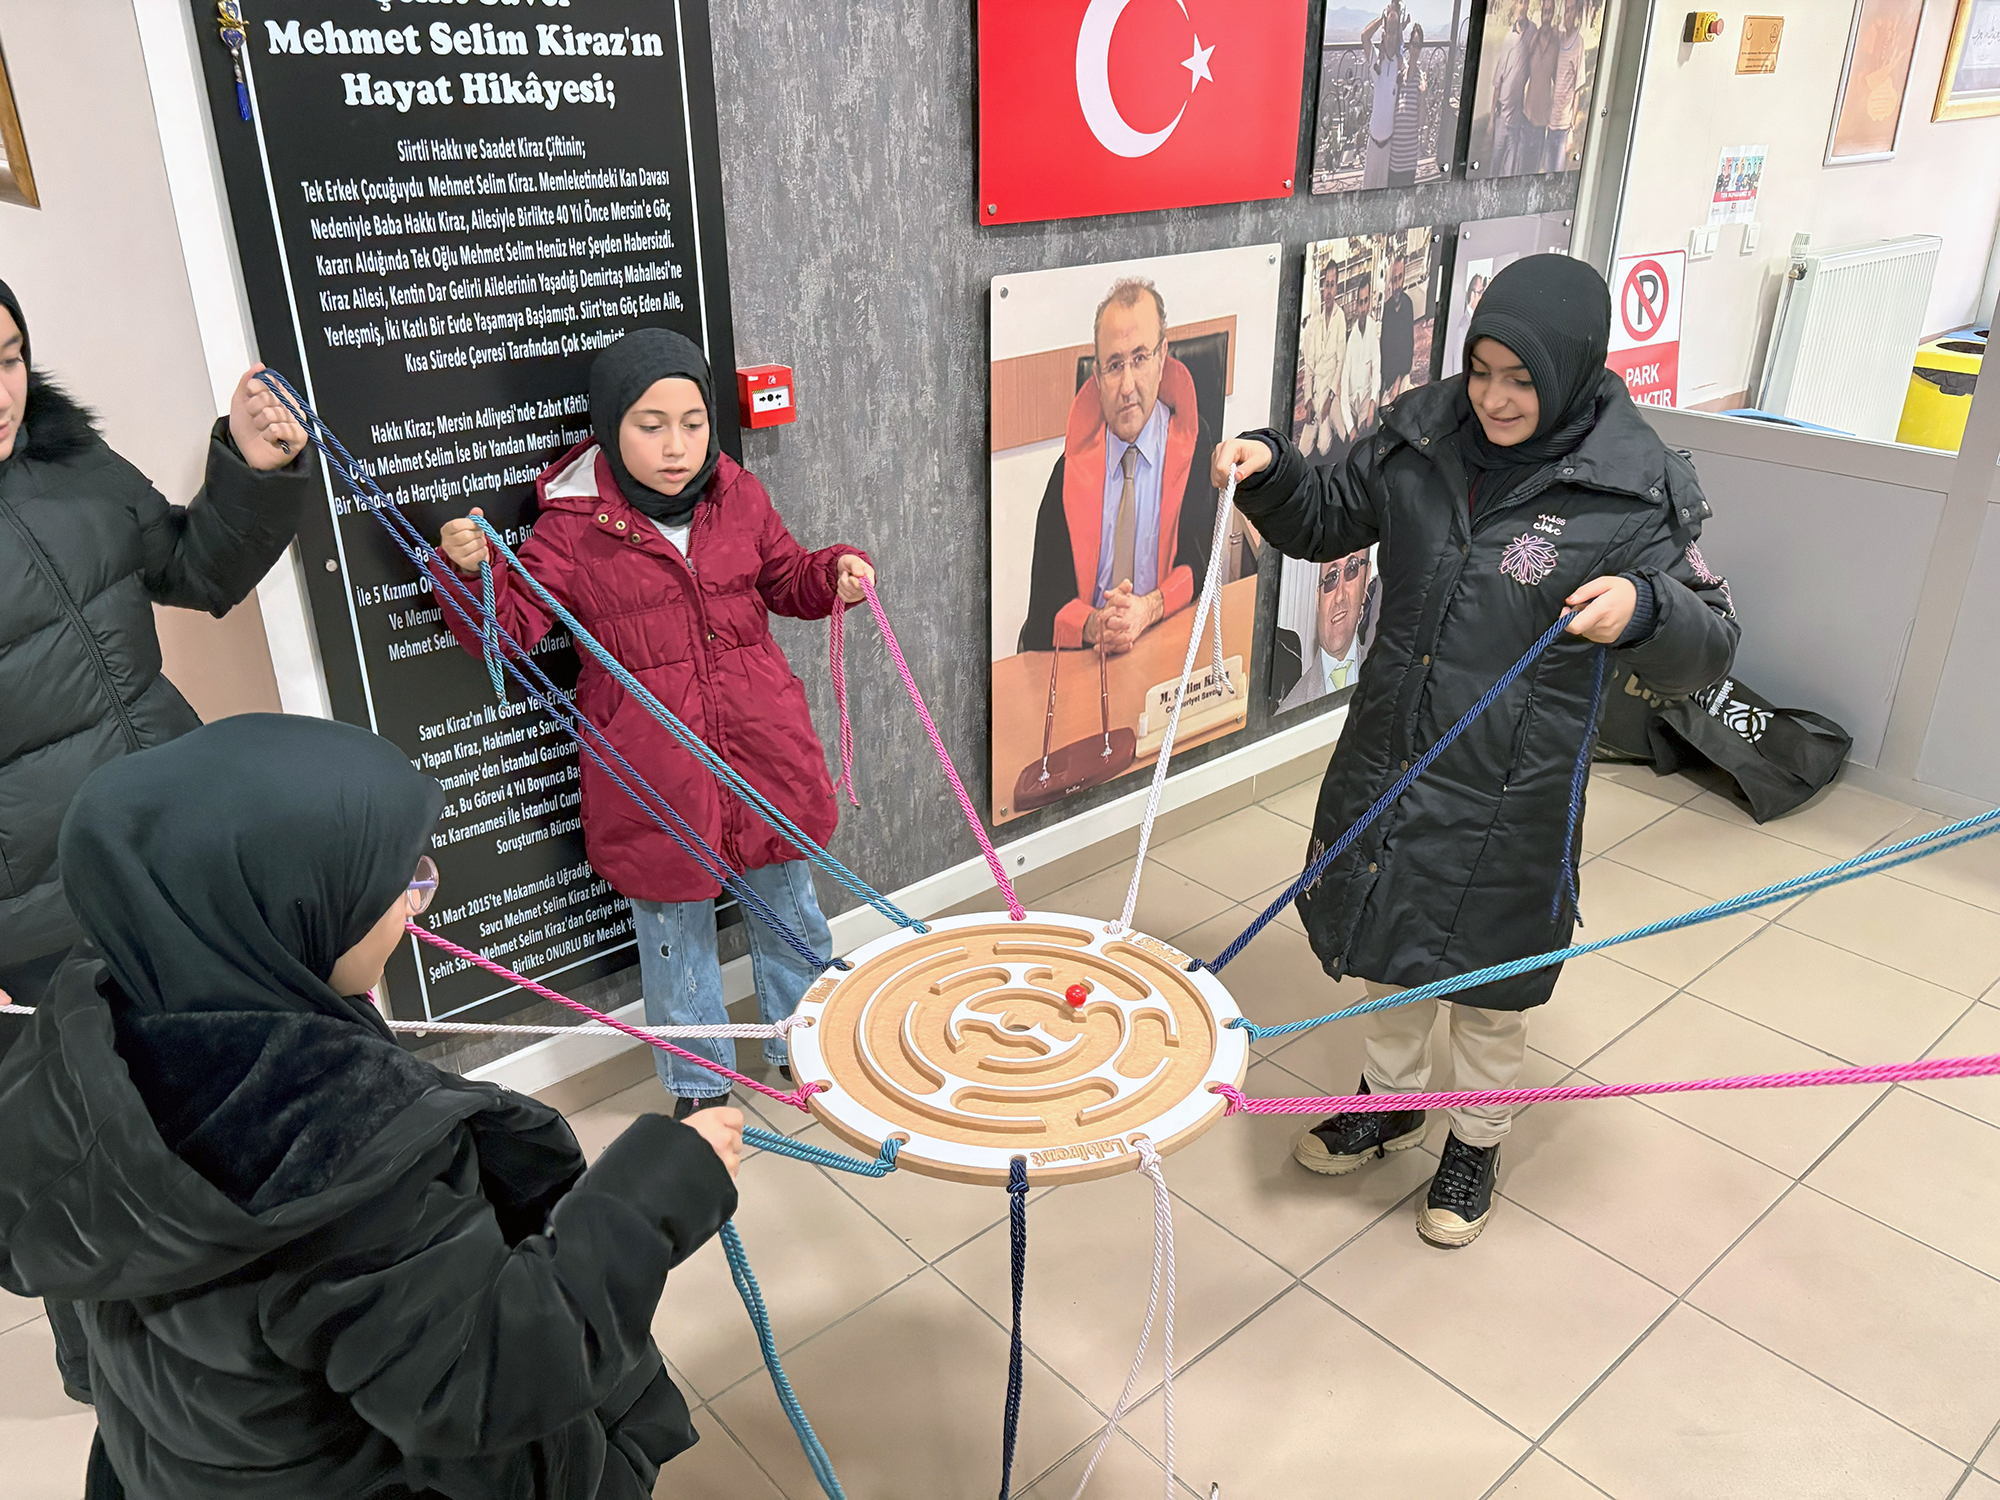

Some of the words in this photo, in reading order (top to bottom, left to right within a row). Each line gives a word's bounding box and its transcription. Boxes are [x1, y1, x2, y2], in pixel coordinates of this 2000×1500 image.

[264, 20, 422, 55] Mehmet
[429, 21, 529, 55] Selim
[535, 24, 664, 57] Kiraz'ın
[341, 72, 454, 113] Hayat
[459, 71, 616, 111] Hikâyesi;
[397, 138, 430, 162] Siirtli
[430, 138, 463, 161] Hakkı
[463, 143, 478, 160] ve
[479, 136, 517, 159] Saadet
[517, 136, 545, 158] Kiraz
[545, 135, 586, 162] Çiftinin;
[300, 179, 325, 203] Tek
[324, 178, 360, 202] Erkek
[360, 175, 424, 205] Çocuğuydu
[428, 174, 476, 197] Mehmet
[476, 172, 507, 195] Selim
[507, 172, 538, 193] Kiraz.
[538, 167, 618, 192] Memleketindeki
[619, 168, 638, 188] Kan
[638, 167, 670, 186] Davası
[310, 214, 372, 242] Nedeniyle
[372, 213, 403, 236] Baba
[403, 211, 437, 234] Hakkı
[437, 210, 470, 234] Kiraz,
[471, 206, 516, 233] Ailesiyle
[516, 205, 555, 227] Birlikte
[556, 204, 569, 224] 40
[569, 202, 583, 223] Yıl
[584, 198, 610, 223] Önce
[610, 198, 652, 221] Mersin'e
[652, 198, 671, 221] Göç
[315, 255, 354, 276] Kararı
[356, 248, 410, 277] Aldığında
[410, 246, 432, 269] Tek
[432, 245, 459, 272] Oğlu
[459, 243, 505, 265] Mehmet
[505, 240, 535, 262] Selim
[535, 238, 568, 259] Henüz
[568, 237, 586, 257] Her
[587, 233, 623, 260] Şeyden
[623, 229, 675, 252] Habersizdi.
[319, 290, 351, 312] Kiraz
[352, 286, 389, 310] Ailesi,
[388, 283, 426, 306] Kentin
[426, 282, 447, 302] Dar
[448, 277, 483, 300] Gelirli
[484, 273, 538, 297] Ailelerinin
[537, 269, 579, 295] Yaşadığı
[580, 266, 624, 289] Demirtaş
[624, 260, 682, 283] Mahallesi'ne
[323, 322, 385, 349] Yerleşmiş,
[384, 316, 401, 341] İki
[401, 316, 428, 339] Katlı
[429, 315, 446, 336] Bir
[446, 312, 473, 334] Evde
[473, 312, 525, 335] Yaşamaya
[525, 304, 579, 329] Başlamıştı.
[580, 298, 619, 320] Siirt'ten
[619, 296, 638, 318] Göç
[638, 293, 662, 313] Eden
[663, 290, 684, 312] Aile,
[404, 353, 429, 373] Kısa
[429, 346, 468, 370] Sürede
[468, 341, 507, 369] Çevresi
[506, 336, 560, 360] Tarafından
[560, 333, 580, 357] Çok
[580, 327, 625, 351] Sevilmi
[1626, 363, 1660, 388] PARK
[1630, 389, 1672, 406] AKTIR
[370, 421, 404, 444] Hakkı
[404, 418, 436, 439] Kiraz;
[436, 411, 474, 434] Mersin
[475, 402, 536, 430] Adliyesi'nde
[536, 398, 563, 419] Zabıt
[378, 452, 424, 476] Mehmet
[424, 447, 455, 468] Selim
[454, 440, 472, 463] İse
[472, 441, 487, 460] Bir
[488, 435, 526, 458] Yandan
[526, 430, 560, 452] Mersin
[561, 424, 588, 445] İmam
[335, 496, 352, 516] Bir
[396, 485, 410, 506] da
[410, 478, 461, 504] Harçlığını
[462, 472, 502, 497] Çıkartıp
[503, 464, 542, 486] Ailesine
[506, 528, 518, 546] En
[356, 586, 372, 607] İle
[372, 586, 381, 604] 5
[382, 582, 418, 602] Kızının
[388, 613, 404, 630] Ve
[405, 608, 441, 627] Memur
[388, 637, 433, 661] Mehmet
[540, 630, 572, 653] Olarak
[1174, 682, 1201, 699] Slim
[418, 723, 446, 741] Savcı
[446, 711, 483, 734] Kiraz'ın
[483, 704, 499, 724] İlk
[527, 692, 544, 712] Yer
[424, 749, 453, 770] Yapan
[453, 742, 482, 760] Kiraz,
[482, 727, 525, 752] Hakimler
[526, 725, 538, 739] ve
[438, 762, 500, 792] smaniye'den
[500, 748, 539, 774] İstanbul
[540, 730, 579, 762] Gaziosm
[440, 799, 459, 820] raz,
[459, 797, 473, 813] Bu
[473, 785, 506, 808] Görevi
[506, 783, 513, 798] 4
[513, 778, 526, 796] Yıl
[526, 771, 565, 792] Boyunca
[430, 833, 448, 849] Yaz
[447, 811, 507, 844] Kararnamesi
[507, 806, 521, 825] İle
[520, 794, 558, 820] İstanbul
[496, 828, 549, 855] Soruşturma
[550, 817, 581, 837] Bürosu
[428, 912, 442, 930] 31
[442, 904, 467, 925] Mart
[467, 893, 503, 916] 2015'te
[503, 874, 556, 904] Makamında
[479, 919, 504, 937] Savcı
[504, 904, 542, 929] Mehmet
[542, 896, 567, 914] Selim
[568, 888, 590, 905] Kiraz
[591, 879, 606, 897] Evli
[429, 961, 454, 984] Şehit
[518, 929, 544, 948] Selim
[544, 914, 584, 939] Kiraz'dan
[585, 904, 613, 923] Geriye
[512, 953, 545, 974] Birlikte
[545, 936, 582, 962] ONURLU
[582, 932, 595, 948] Bir
[596, 919, 626, 942] Meslek
[1030, 1137, 1128, 1167] Labirent
